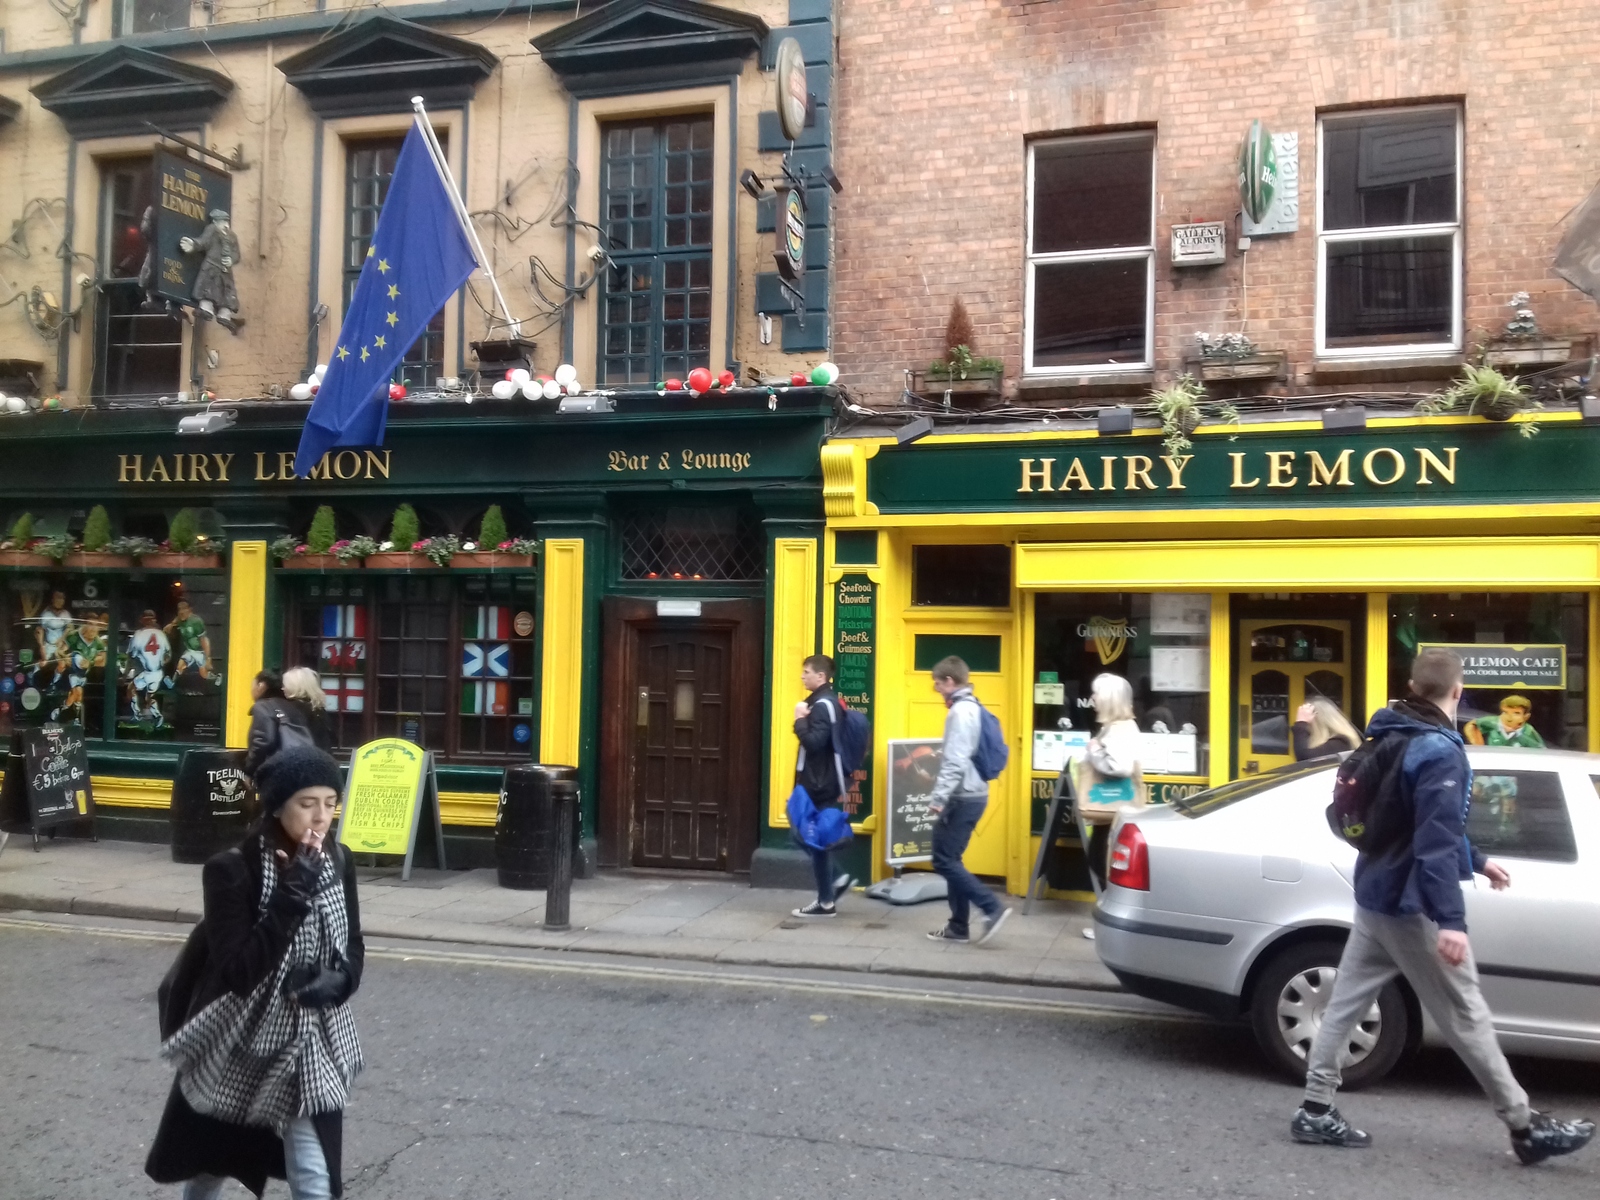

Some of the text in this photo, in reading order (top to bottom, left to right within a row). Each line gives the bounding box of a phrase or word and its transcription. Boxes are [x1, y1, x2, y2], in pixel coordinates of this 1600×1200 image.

[162, 172, 208, 204] HAIRY
[161, 190, 206, 221] LEMON
[1180, 237, 1216, 246] ALARMS
[117, 450, 393, 482] HAIRY LEMON
[607, 449, 751, 473] Bar & Lounge
[1016, 447, 1461, 493] HAIRY LEMON
[83, 580, 97, 598] 6
[144, 633, 160, 656] 4
[1470, 657, 1520, 668] LEMON
[1522, 657, 1559, 669] CAFE
[1476, 669, 1499, 677] COOK
[1500, 669, 1522, 677] BOOK
[1523, 669, 1539, 677] FOR
[861, 692, 870, 704] &
[381, 821, 405, 829] CHIPS
